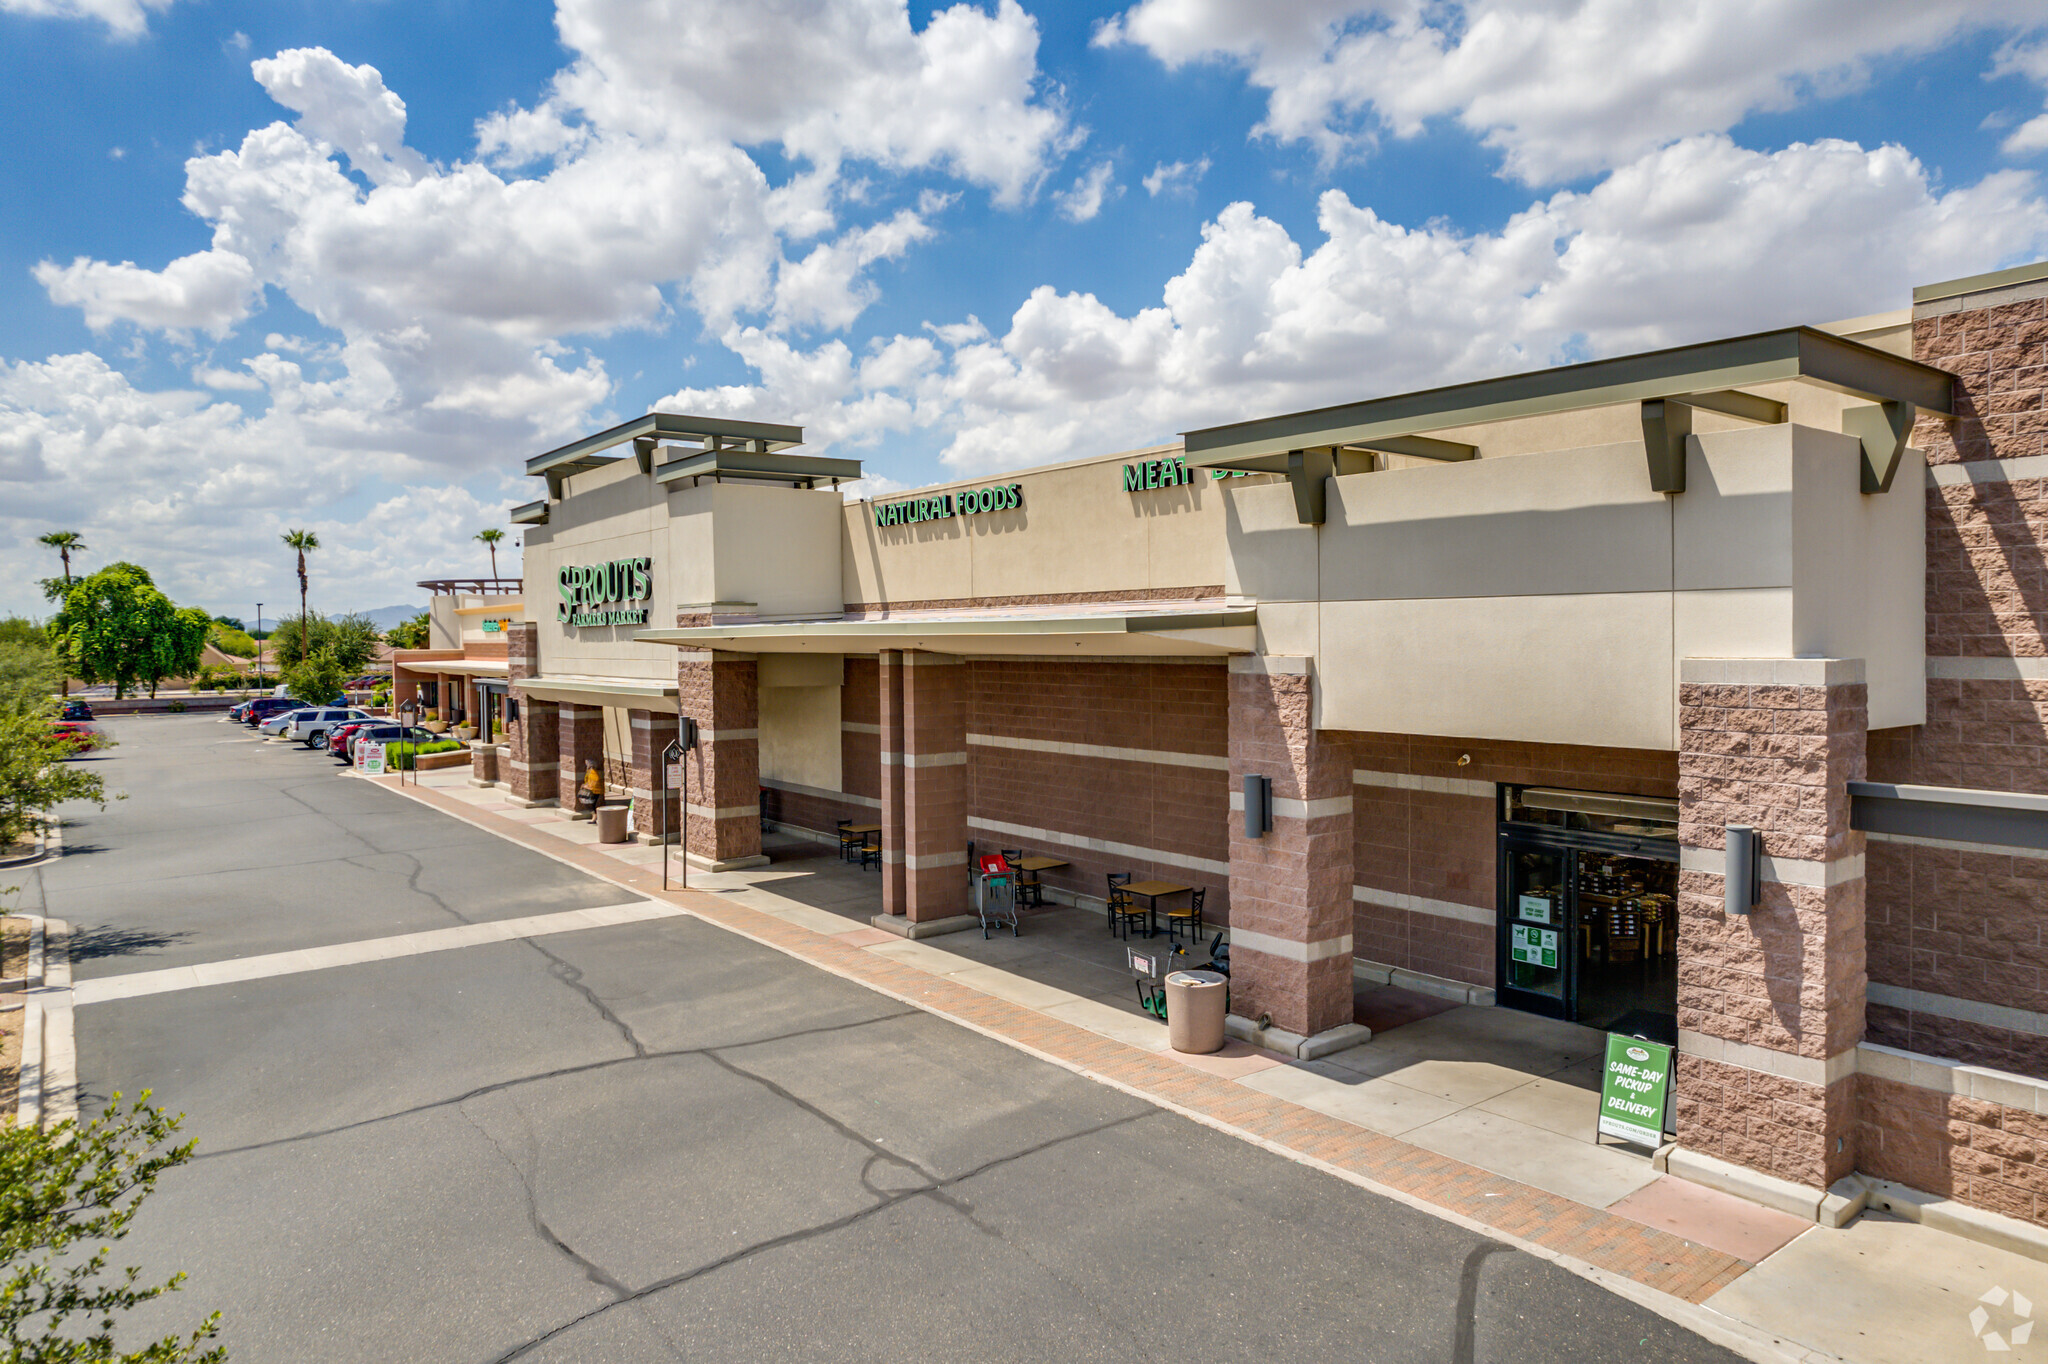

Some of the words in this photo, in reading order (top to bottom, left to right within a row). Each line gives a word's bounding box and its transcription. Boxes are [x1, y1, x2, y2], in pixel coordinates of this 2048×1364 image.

[1122, 456, 1190, 492] MEAT
[874, 495, 953, 528] NATURAL
[956, 483, 1020, 516] FOODS
[557, 557, 651, 624] SPROUTS
[572, 613, 607, 627] FARMERS
[608, 609, 646, 626] MARKET
[1609, 1061, 1663, 1083] SAME-DAY
[1614, 1075, 1653, 1094] PICKUP
[1608, 1096, 1657, 1118] DELIVERY
[1630, 1092, 1636, 1100] &
[1602, 1119, 1657, 1139] SPROUTS.COM/ORDER
